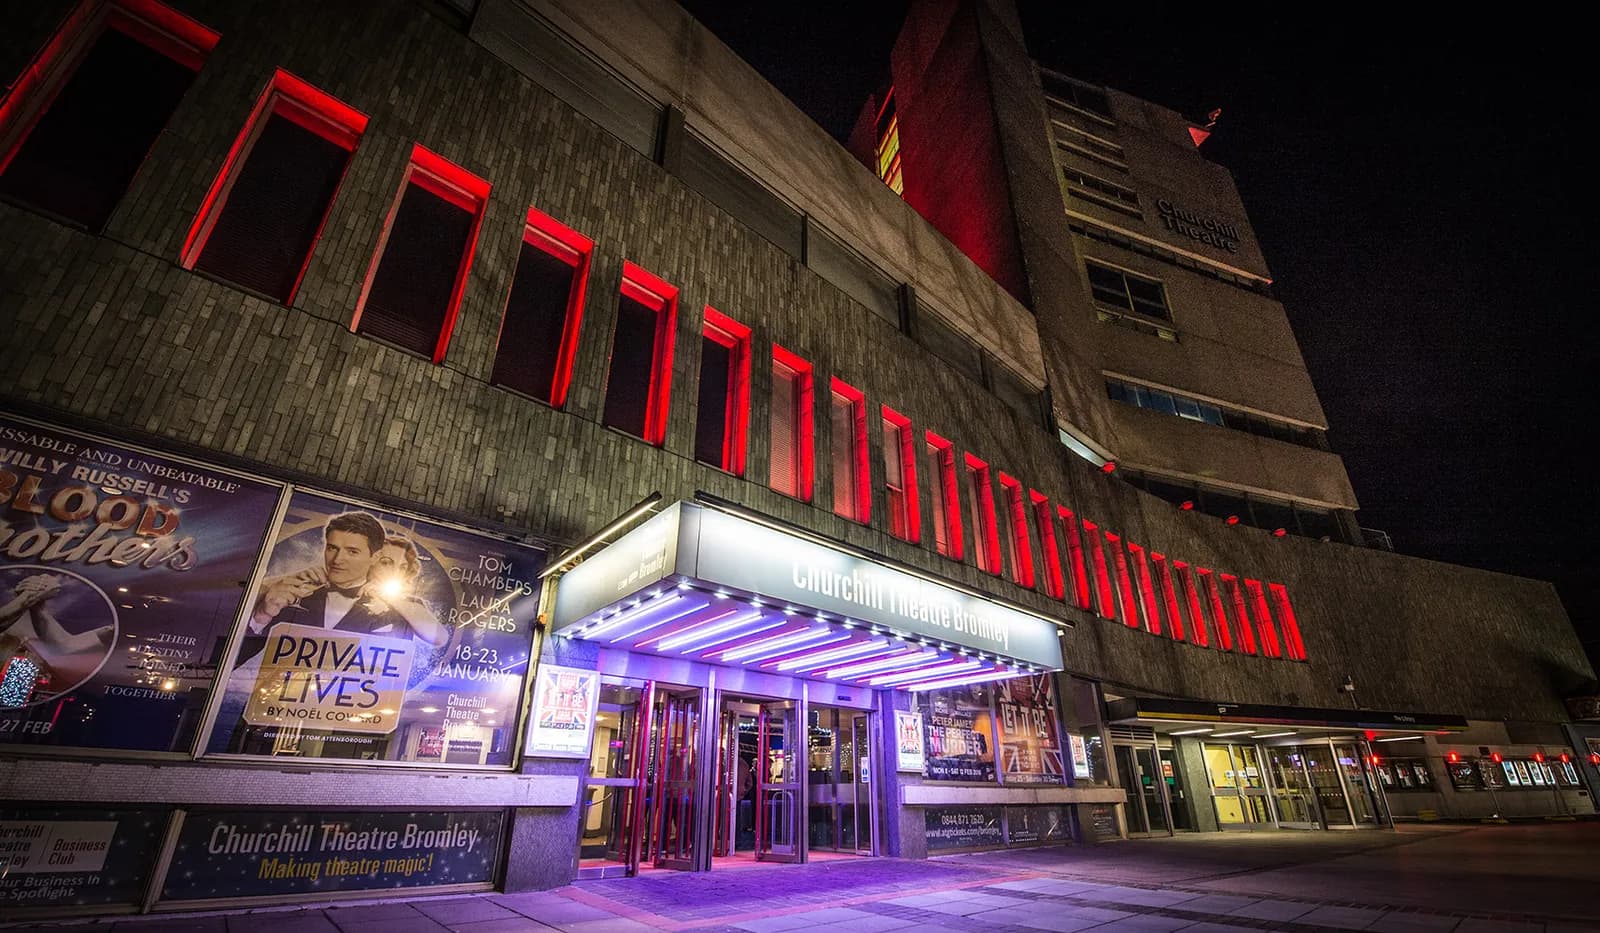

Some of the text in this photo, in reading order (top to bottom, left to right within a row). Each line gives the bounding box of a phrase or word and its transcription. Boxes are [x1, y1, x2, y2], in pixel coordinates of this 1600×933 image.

[1157, 199, 1240, 241] Churchill
[1162, 214, 1238, 253] Theatre
[79, 447, 122, 465] AND
[72, 465, 191, 504] RUSSELL'S
[479, 554, 513, 575] TOM
[449, 567, 532, 596] CHAMBERS
[460, 592, 511, 615] LAURA
[793, 560, 1009, 651] Churchill Theatre Bromley
[448, 609, 516, 633] ROGERS
[159, 632, 197, 646] THEIR
[137, 644, 193, 659] DESTINY
[272, 635, 405, 678] PRIVATE
[455, 645, 498, 664] 18-23
[103, 685, 177, 701] TOGETHER
[278, 671, 379, 709] LIVES
[448, 693, 487, 709] Churchill
[267, 706, 285, 717] BY
[286, 707, 322, 721] NOËL
[446, 706, 479, 720] Theatre
[931, 715, 953, 726] PETER
[1002, 703, 1049, 738] LET IT BE
[0, 719, 52, 734] 27 FEB
[928, 725, 980, 741] THE PERFECT
[929, 736, 983, 756] MURDER
[933, 766, 944, 774] MON
[951, 767, 959, 775] SAT
[54, 838, 107, 851] Business
[208, 823, 479, 854] Churchill Theatre Bromley
[48, 852, 75, 866] Club
[258, 853, 434, 881] Making theatre magic!
[24, 875, 84, 888] Business
